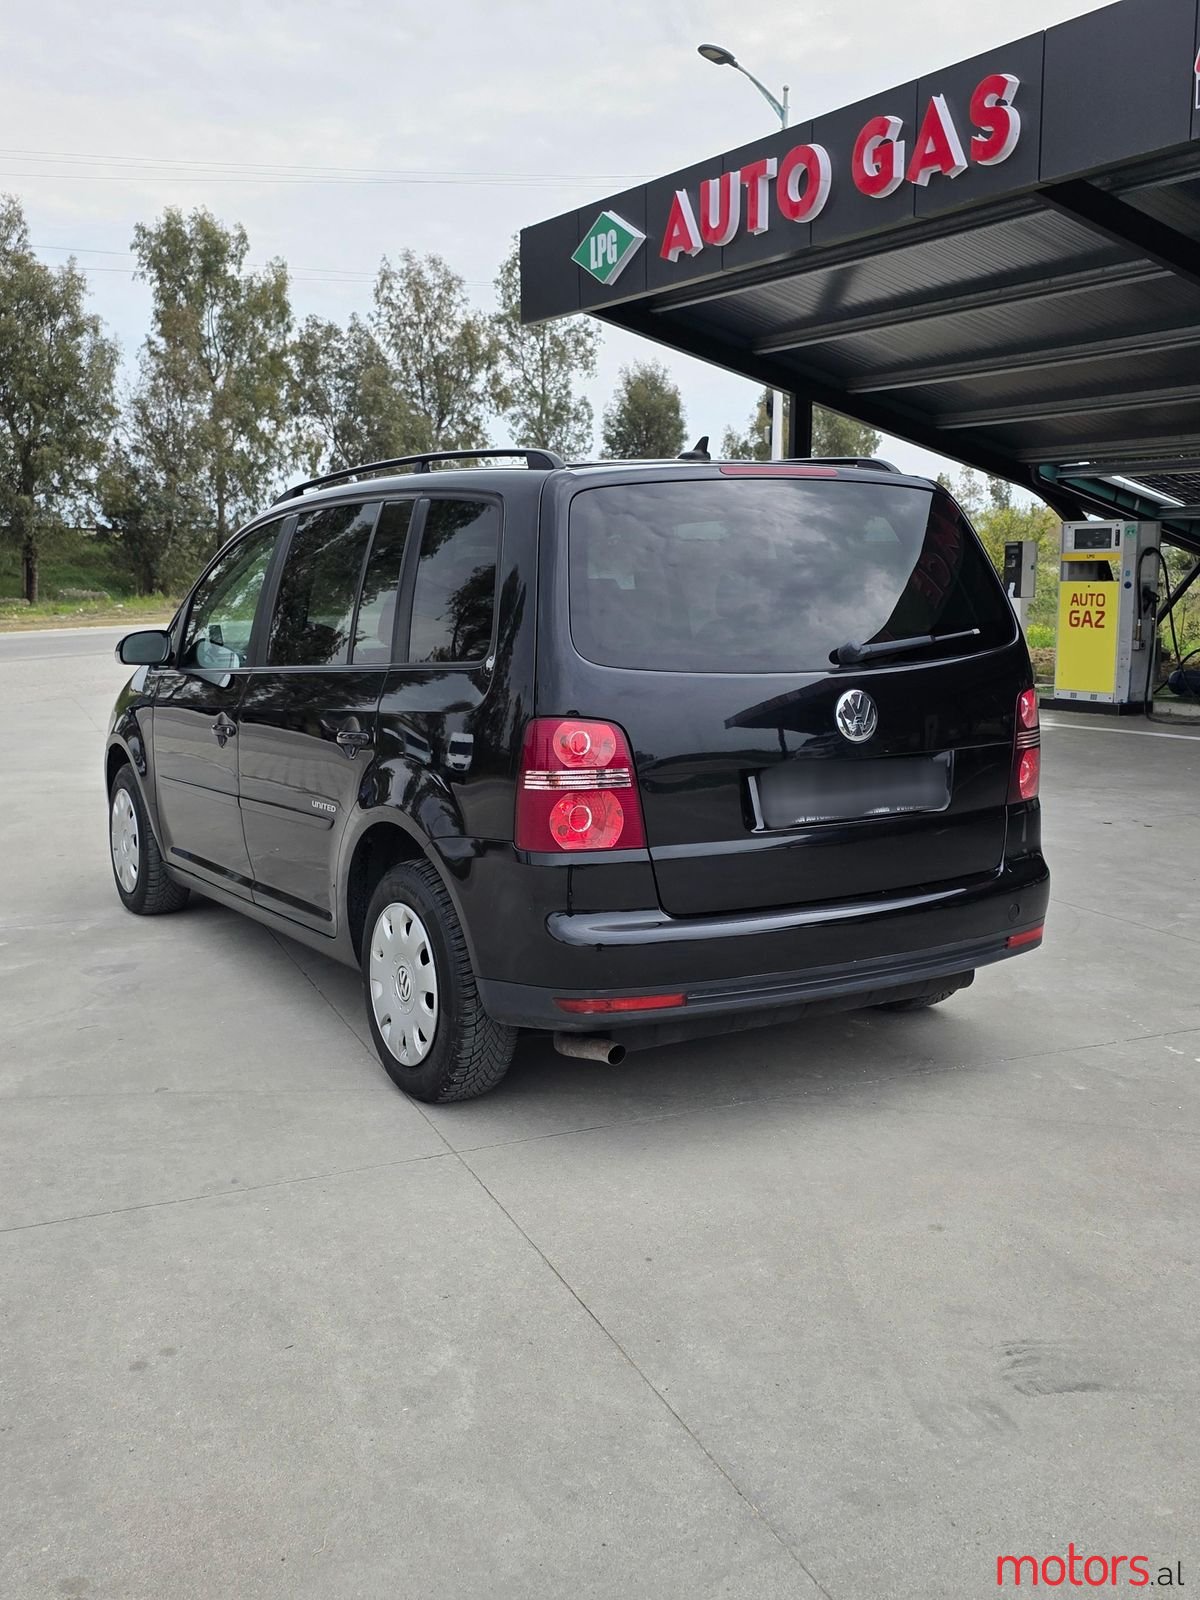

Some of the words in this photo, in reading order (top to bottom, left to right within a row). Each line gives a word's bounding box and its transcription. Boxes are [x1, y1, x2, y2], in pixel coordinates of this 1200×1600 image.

[660, 144, 832, 262] AUTO
[852, 74, 1021, 198] GAS
[590, 229, 617, 270] LPG
[1070, 593, 1106, 607] AUTO
[1069, 610, 1106, 628] GAZ
[311, 800, 337, 813] UNITED
